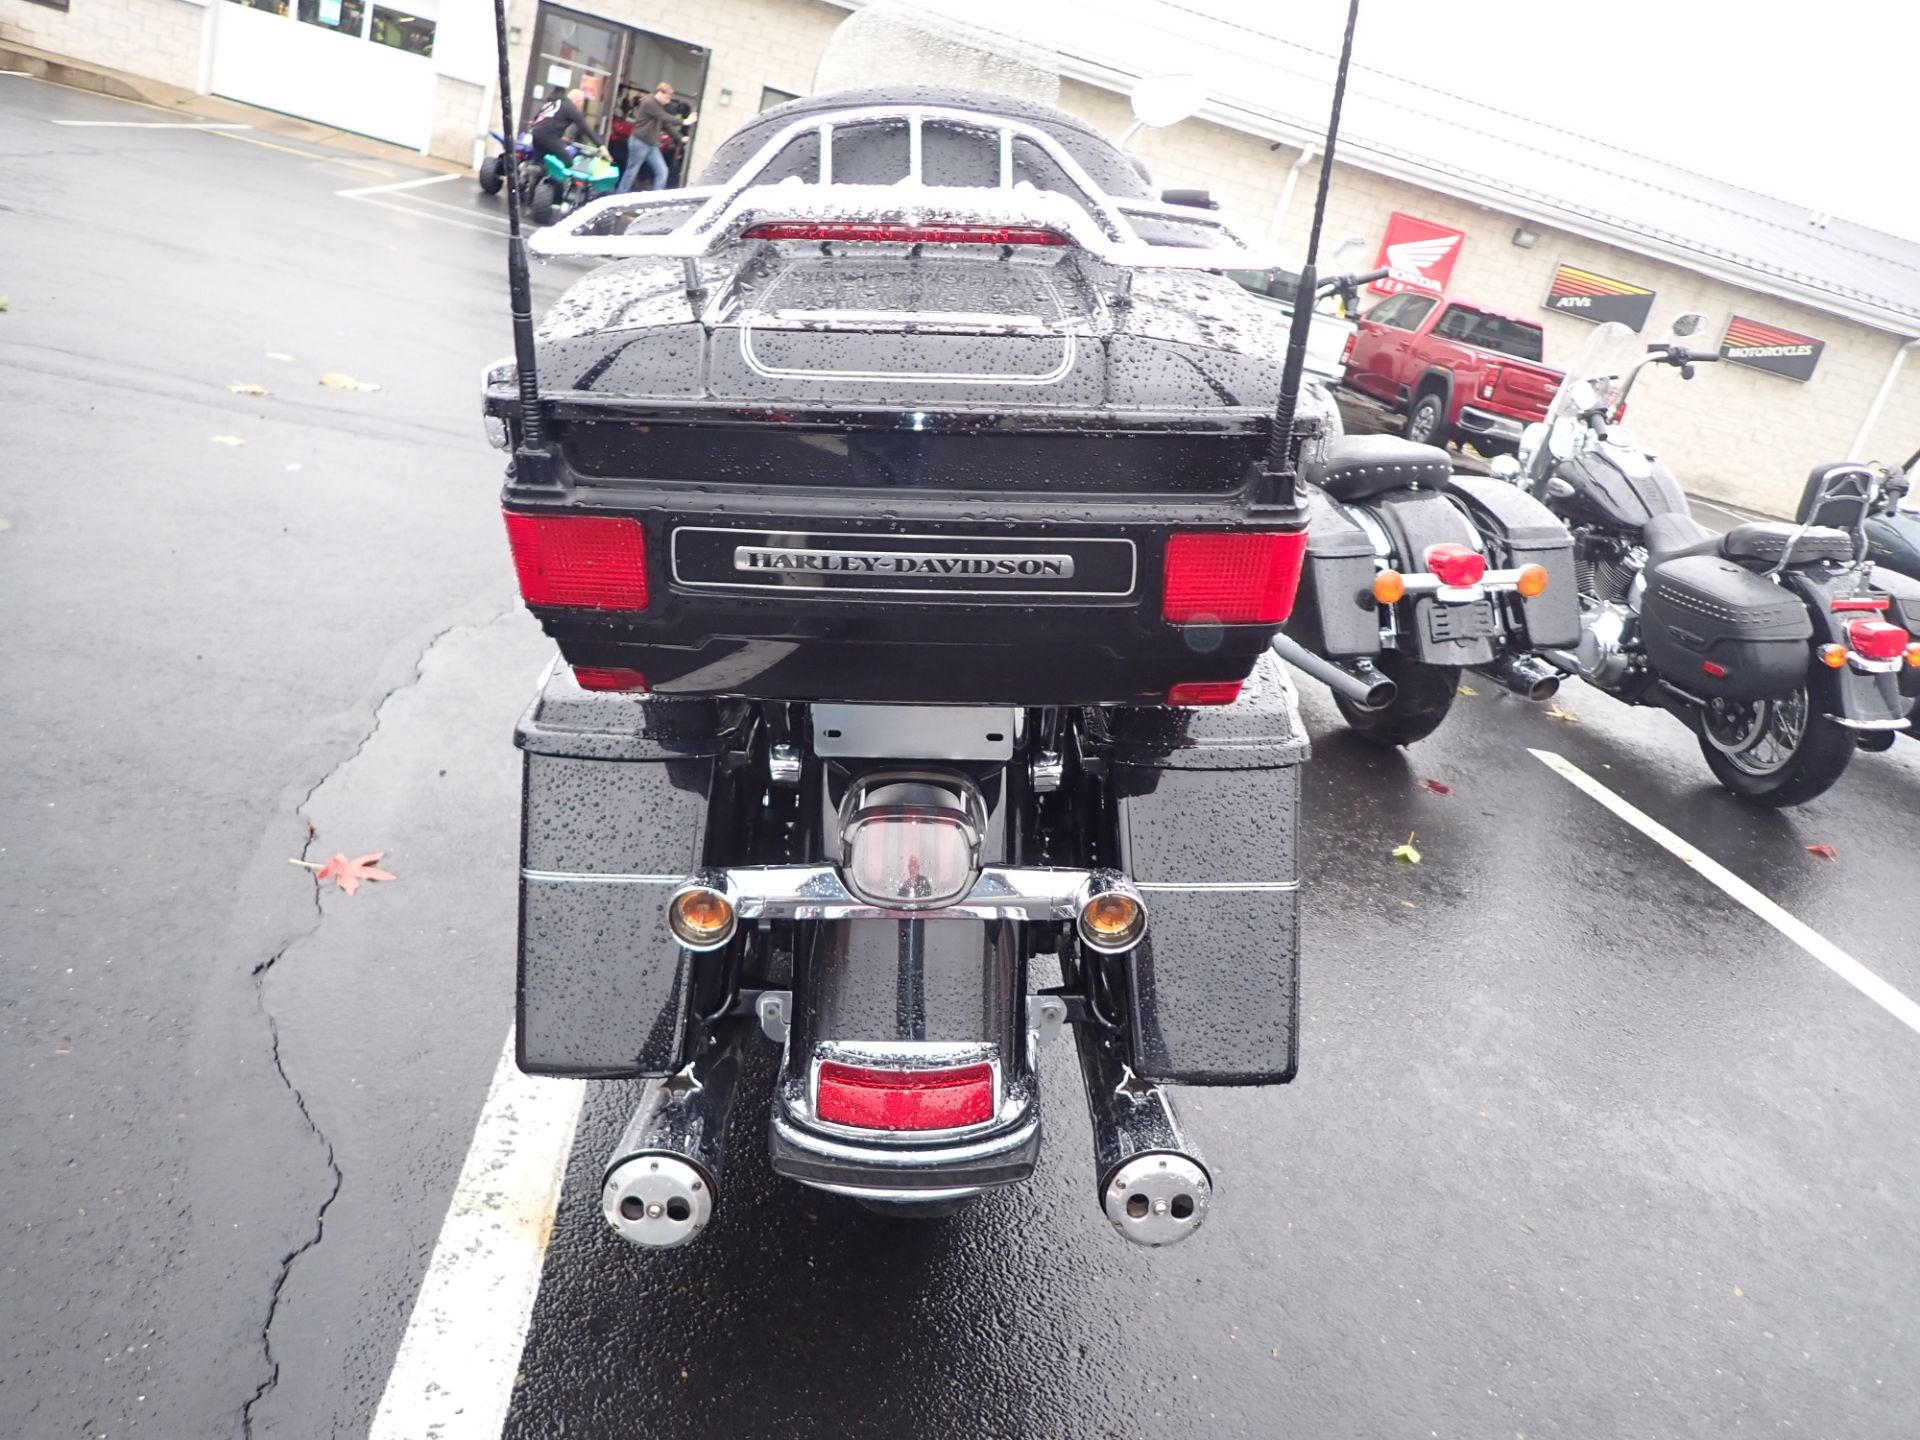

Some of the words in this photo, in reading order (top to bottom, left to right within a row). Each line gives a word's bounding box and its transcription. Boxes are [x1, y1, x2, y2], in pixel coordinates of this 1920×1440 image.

[1556, 296, 1592, 307] ATVs
[1727, 345, 1812, 358] MOTORCYCLES
[747, 552, 1064, 576] HARLEY-DAVIDSON
